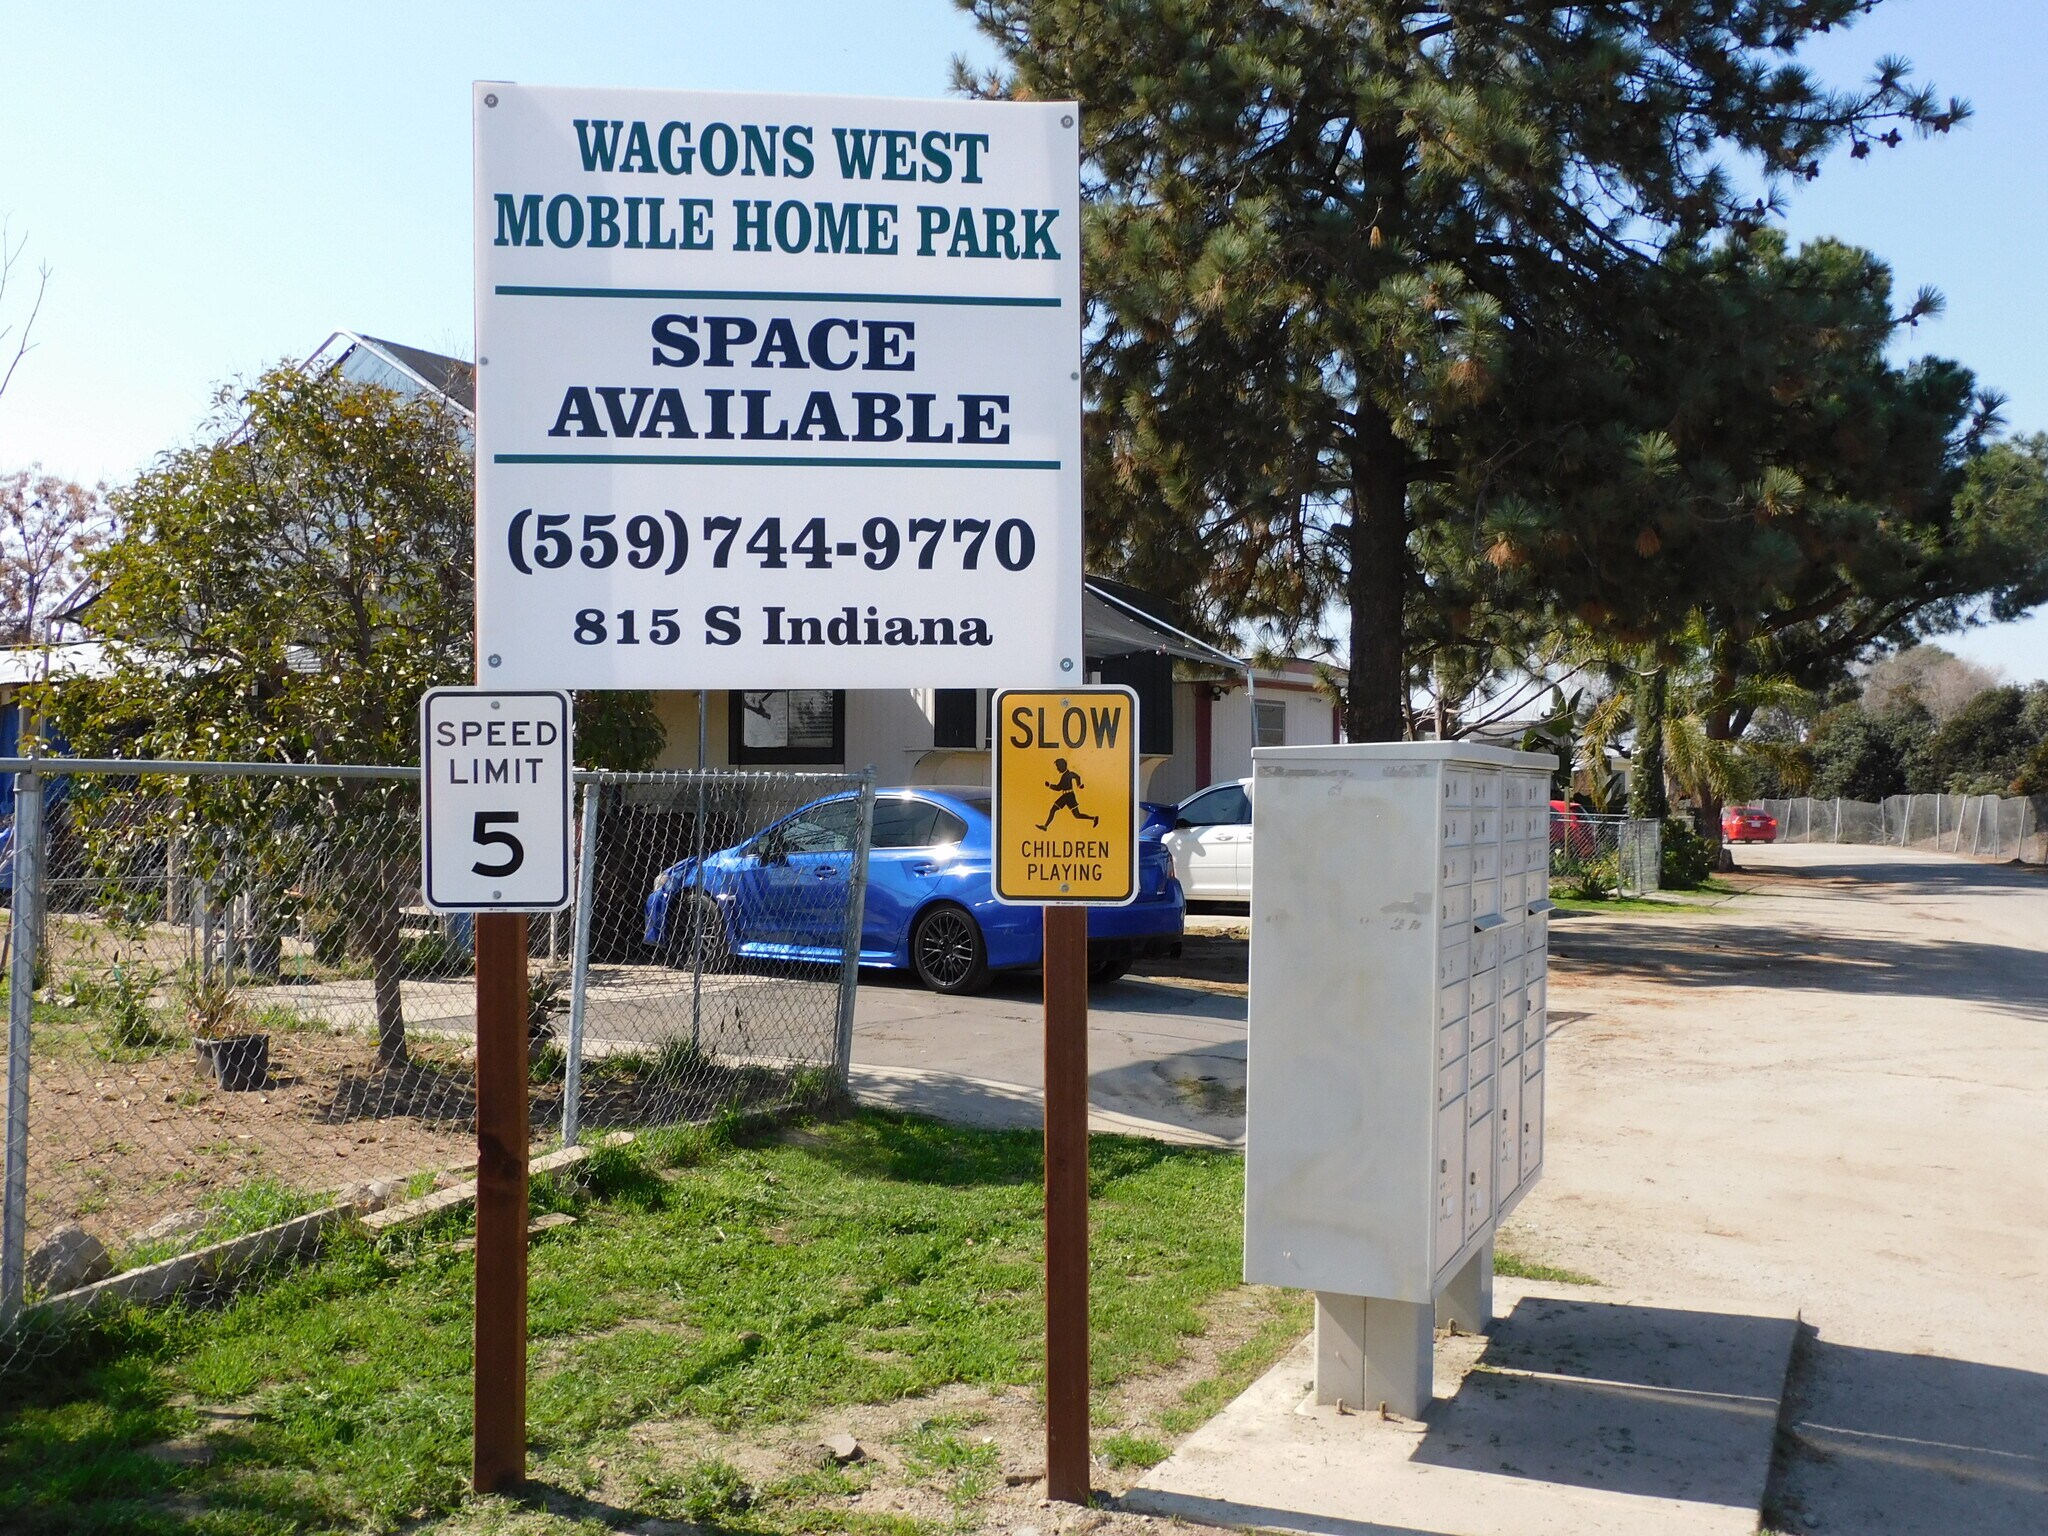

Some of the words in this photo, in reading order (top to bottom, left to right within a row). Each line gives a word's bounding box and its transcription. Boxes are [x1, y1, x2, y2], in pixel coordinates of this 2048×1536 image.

[573, 120, 814, 179] WAGONS
[832, 128, 989, 184] WEST
[494, 194, 713, 250] MOBILE
[733, 200, 898, 255] HOME
[917, 206, 1061, 260] PARK
[652, 314, 915, 371] SPACE
[548, 387, 1009, 444] AVAILABLE
[574, 608, 680, 645] 815
[705, 606, 741, 645] S
[763, 606, 993, 646] Indiana
[437, 721, 557, 746] SPEED
[1010, 706, 1122, 749] SLOW
[450, 758, 543, 784] LIMIT
[471, 811, 524, 877] 5
[1022, 841, 1108, 858] CHILDREN
[1028, 864, 1101, 881] PLAYING
